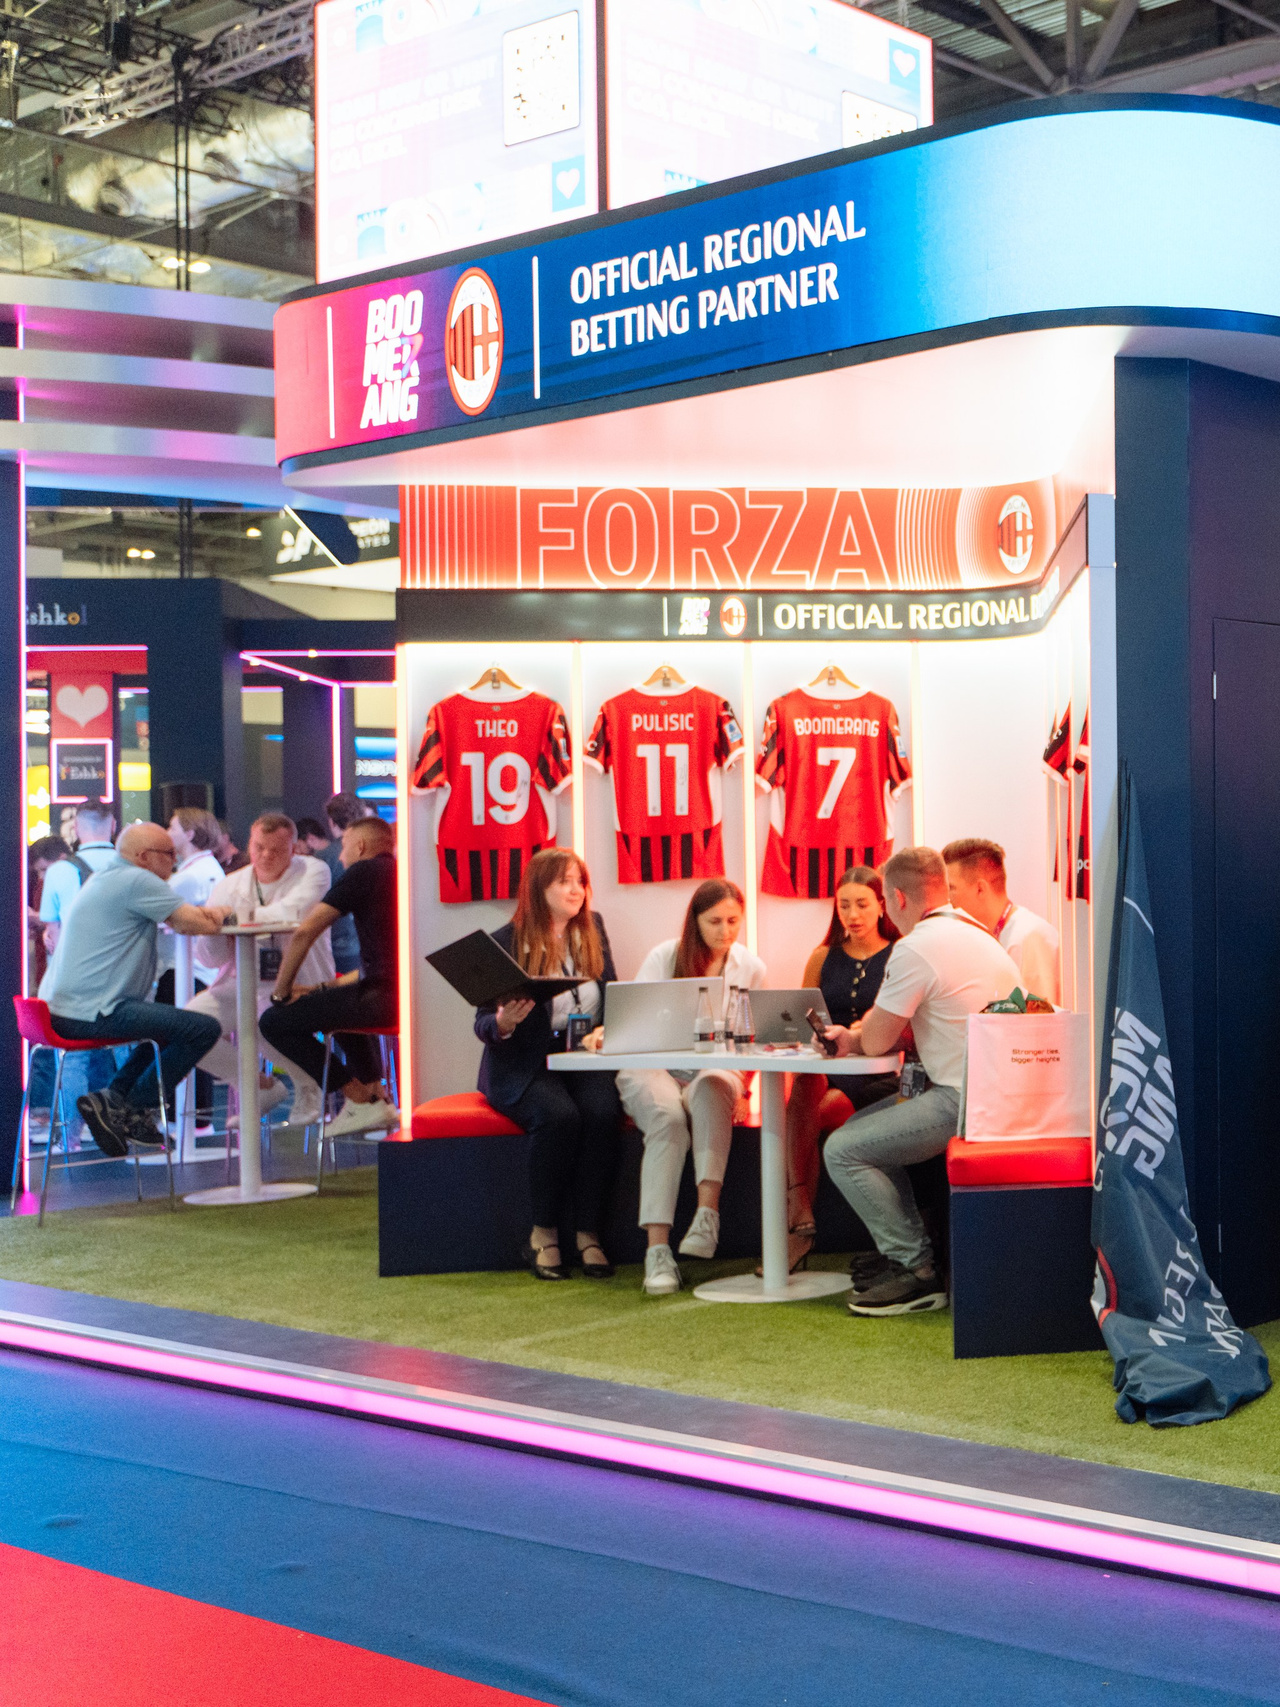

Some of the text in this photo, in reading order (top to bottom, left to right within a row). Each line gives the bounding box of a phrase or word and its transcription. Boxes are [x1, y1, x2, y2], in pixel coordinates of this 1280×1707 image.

[570, 200, 866, 304] OFFICIAL REGIONAL
[366, 289, 424, 344] BOO
[571, 262, 840, 357] BETTING PARTNER
[360, 376, 420, 429] ANG
[516, 485, 893, 590] FORZA
[773, 596, 1030, 631] OFFICIAL REGIONAL
[475, 719, 518, 738] THEO
[631, 713, 694, 732] PULISIC
[793, 716, 880, 738] BOOMERANG
[460, 752, 532, 826] 19
[636, 743, 690, 817] 11
[816, 746, 857, 819] 7
